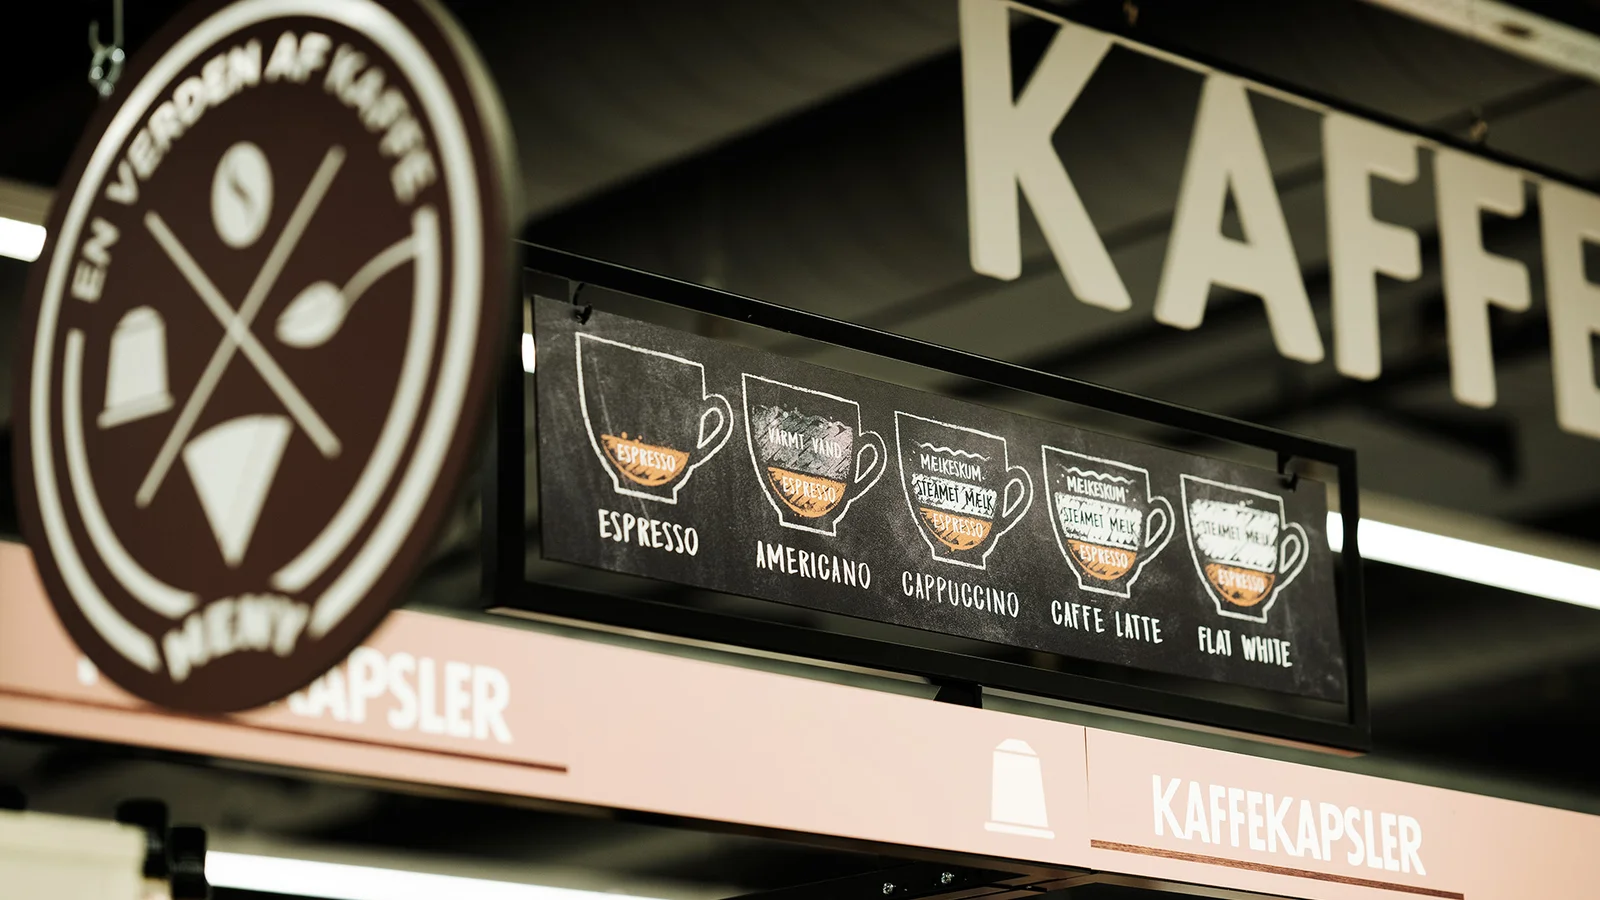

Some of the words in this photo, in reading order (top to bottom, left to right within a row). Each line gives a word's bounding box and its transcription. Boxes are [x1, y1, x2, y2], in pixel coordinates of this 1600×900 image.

[71, 216, 120, 303] EN
[106, 38, 263, 205] VERDEN
[264, 30, 333, 84] AF
[323, 42, 437, 204] KAFFE
[959, 0, 1600, 440] KAFFE
[617, 443, 676, 473] ESPRESSO
[768, 427, 804, 450] VARMT
[812, 437, 842, 459] VAND
[782, 476, 836, 503] ESPRESSO
[917, 480, 959, 503] STEAMET
[598, 508, 699, 556] ESPRESSO
[933, 513, 983, 538] ESPRESSO
[1063, 507, 1104, 528] STEAMET
[756, 540, 871, 589] AMERICANO
[1080, 545, 1128, 569] ESPRESSO
[902, 571, 1019, 618] CAPPUCCINO
[1217, 568, 1265, 593] ESPRESSO
[162, 593, 308, 684] MENY
[1051, 600, 1105, 634] CAFFE
[1115, 611, 1164, 644] LATTE
[1198, 625, 1232, 657] FLAT
[1242, 634, 1293, 669] WHITE
[1151, 774, 1427, 876] KAFFEKAPSLER
